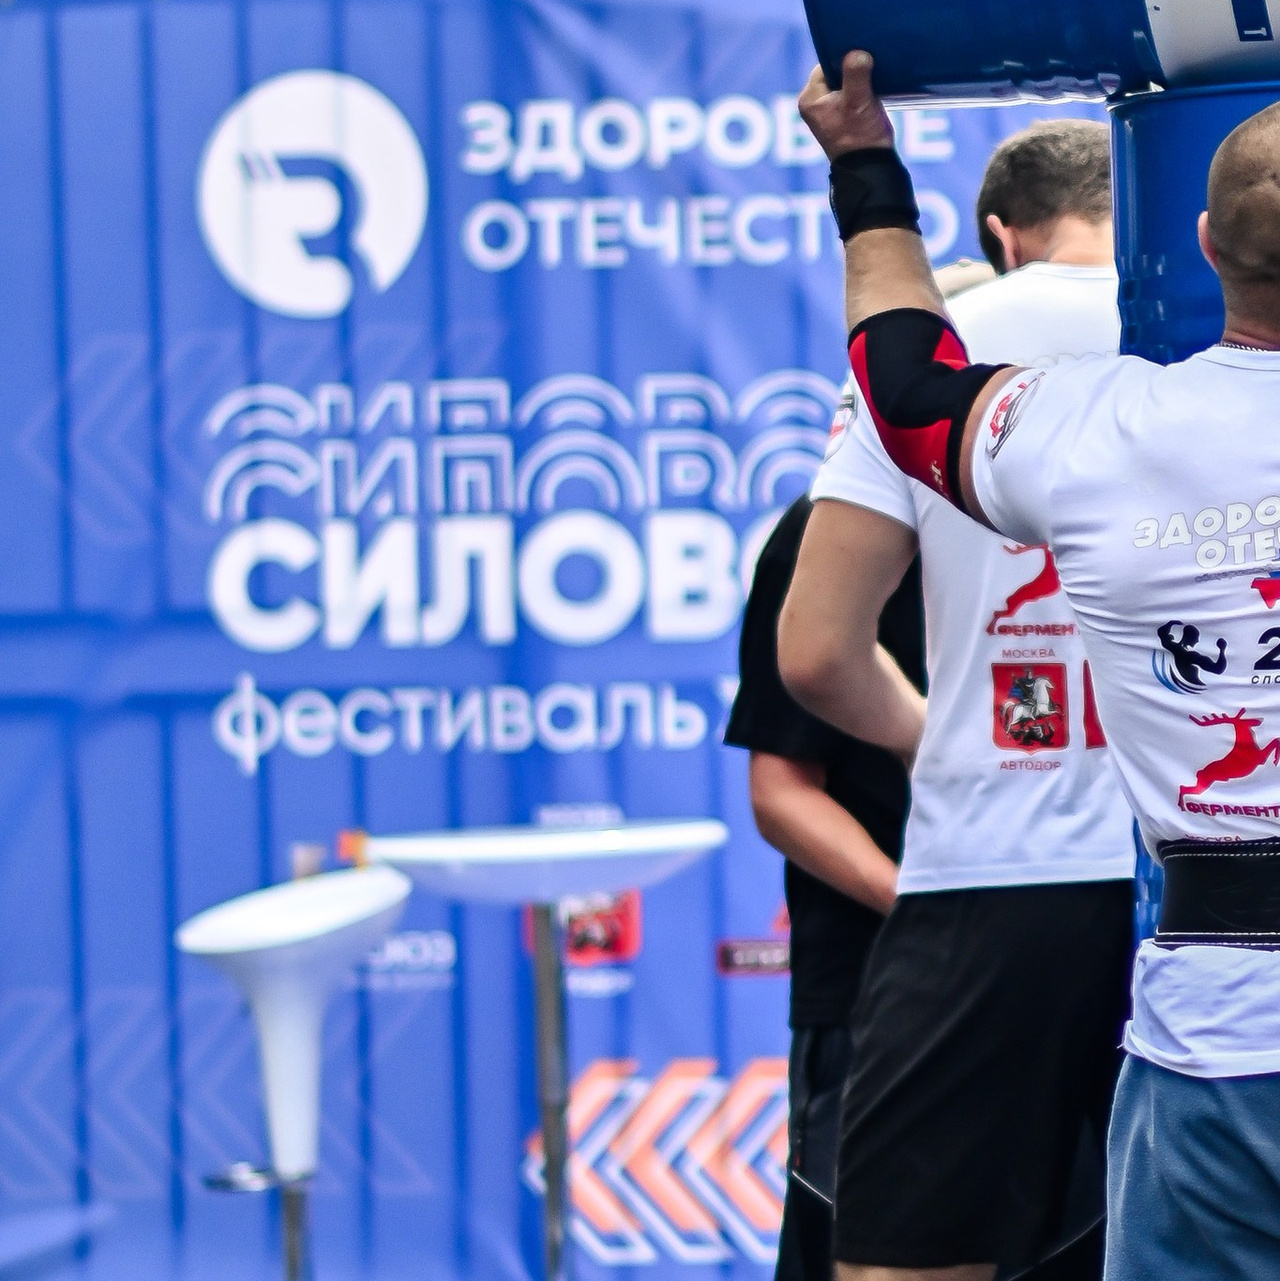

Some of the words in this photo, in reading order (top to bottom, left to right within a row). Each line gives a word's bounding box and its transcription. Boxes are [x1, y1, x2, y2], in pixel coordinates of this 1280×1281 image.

[462, 94, 954, 183] ЗДОРОВЕ
[462, 190, 961, 271] ОТЕЧЕСТО
[208, 507, 772, 649] СИЛОВ
[997, 623, 1080, 637] ФЕРМЕН
[1002, 648, 1056, 659] МОСКВА
[212, 672, 708, 776] фестиваль
[1000, 760, 1062, 772] АВТОДОР
